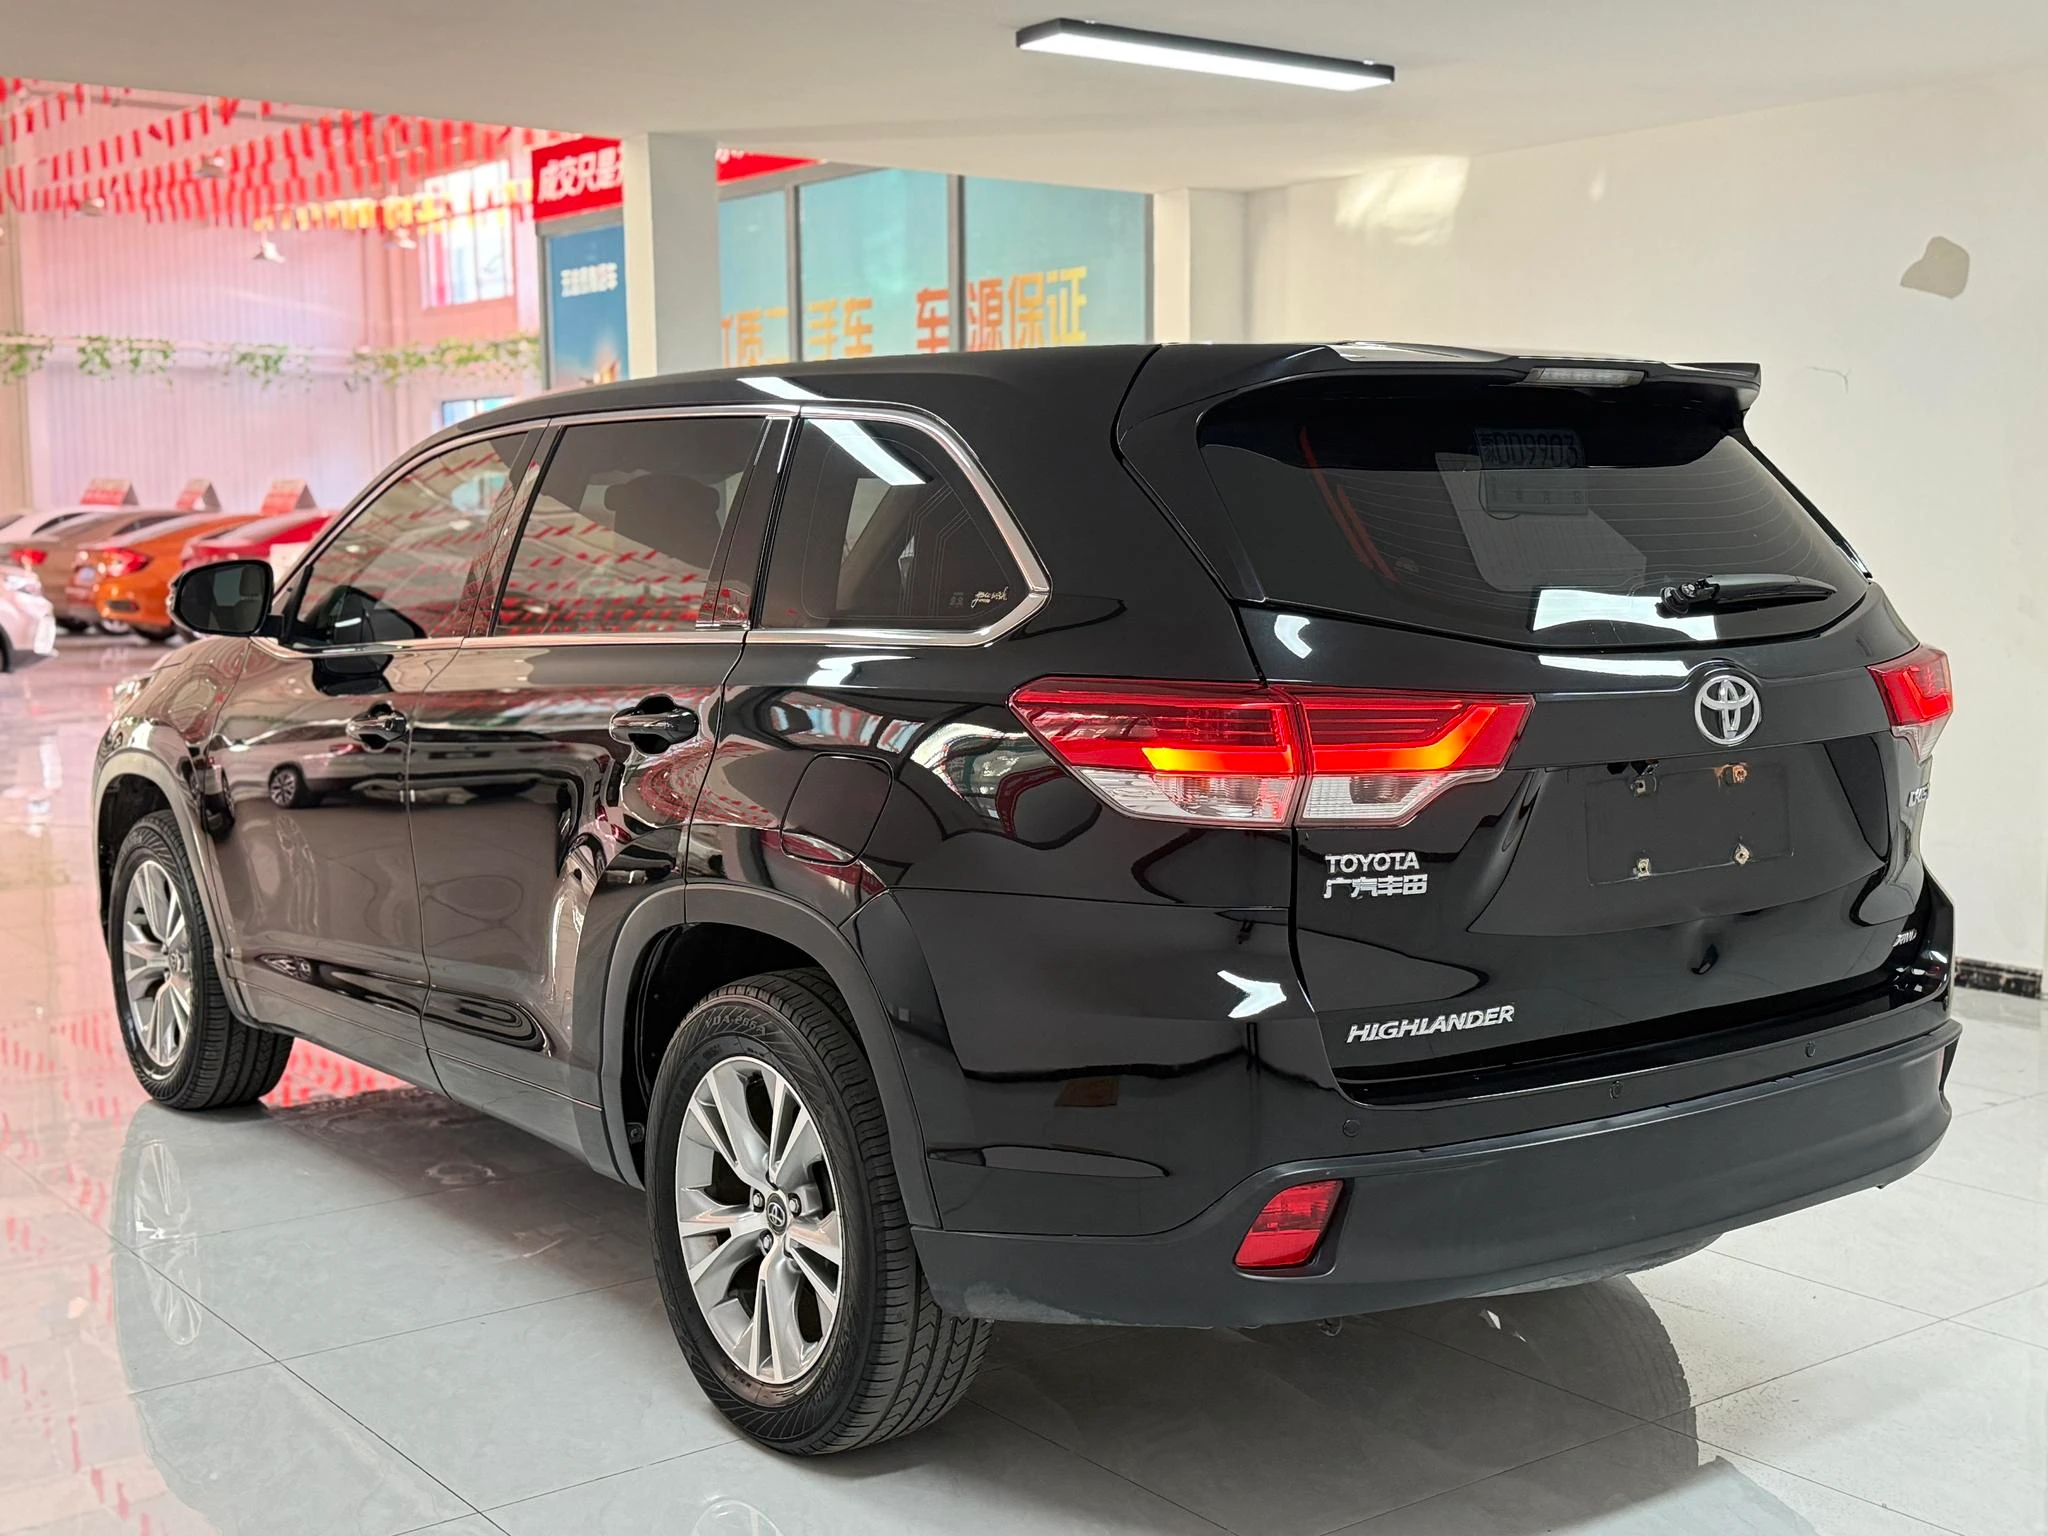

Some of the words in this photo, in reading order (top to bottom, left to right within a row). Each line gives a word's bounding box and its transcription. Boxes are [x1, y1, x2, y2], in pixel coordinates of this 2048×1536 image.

[537, 146, 623, 204] 成交只是
[916, 266, 1088, 354] 车源保证
[1325, 852, 1419, 874] TOYOTA
[1323, 874, 1428, 898] 广汽丰田
[1346, 1005, 1515, 1044] HIGHLANDER
